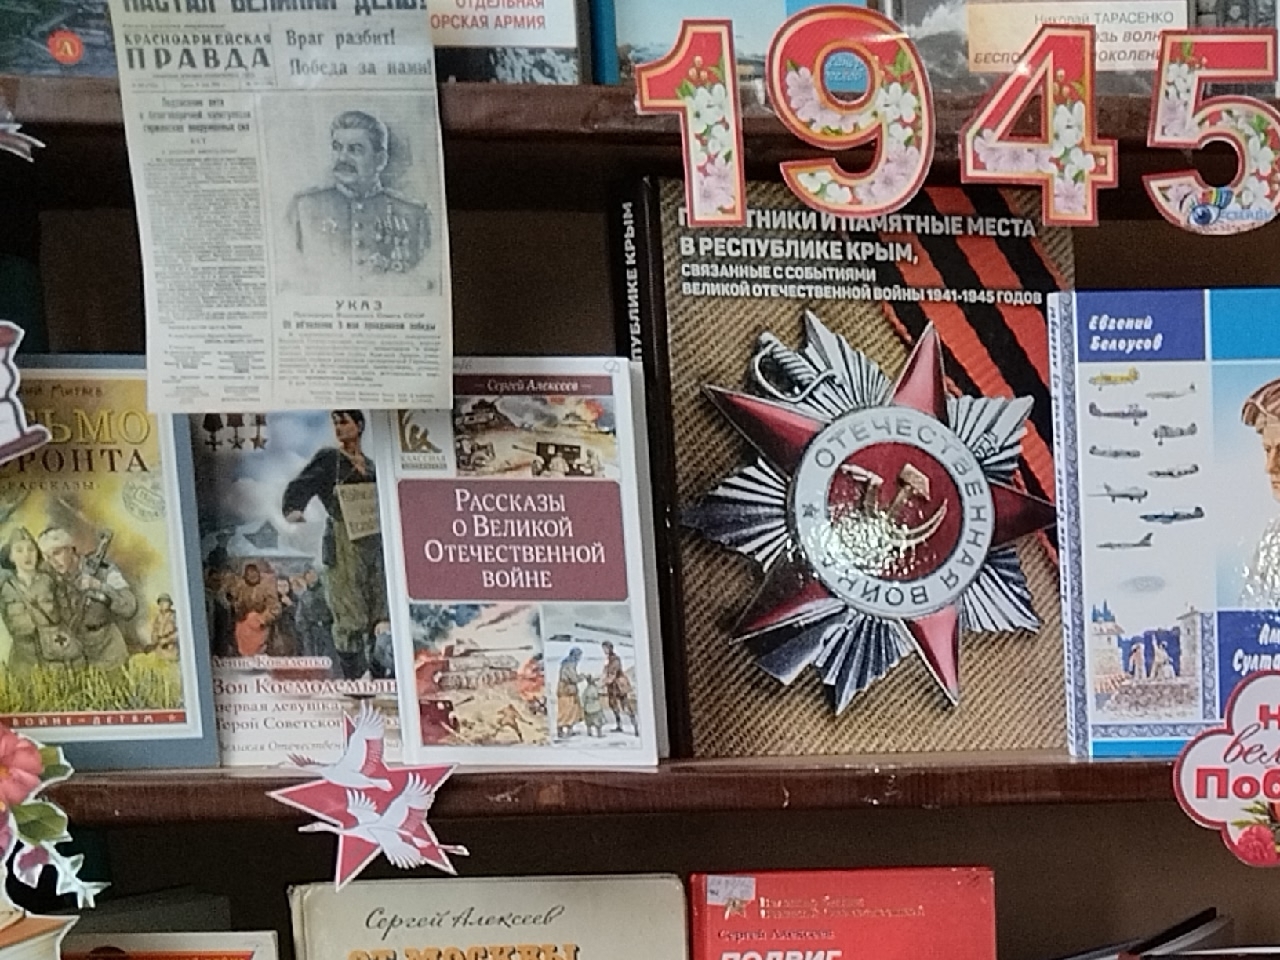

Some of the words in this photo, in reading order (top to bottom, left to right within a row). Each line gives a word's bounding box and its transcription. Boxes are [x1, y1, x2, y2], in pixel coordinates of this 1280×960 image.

[494, 16, 546, 29] АРМИЯ
[1094, 12, 1174, 24] ТАРАСЕНКО
[123, 33, 272, 46] КРАСНОАРМЕЙСКАЯ
[286, 30, 324, 49] Враг
[336, 28, 396, 49] разбит!
[126, 48, 271, 71] ПРАВДА
[290, 58, 348, 75] Победа
[358, 62, 378, 75] за
[387, 59, 432, 76] нами!
[621, 201, 637, 265] КРЫМ
[821, 212, 836, 232] И
[844, 213, 962, 235] ПАМЯТНЫЕ
[972, 215, 1037, 238] МЕСТА
[680, 236, 695, 256] В
[699, 237, 844, 260] РЕСПУБЛИКЕ
[845, 240, 919, 265] КРЫМ,
[681, 263, 772, 280] СВЯЗАННЫЕ
[773, 266, 785, 280] С
[785, 266, 876, 283] СОБЫТИЯМИ
[682, 281, 751, 299] ВЕЛИКОЙ
[752, 282, 872, 302] ОТЕЧЕСТВЕННОЙ
[873, 284, 926, 303] ВОЙНЫ
[926, 289, 995, 304] 1941-1945
[996, 290, 1043, 307] ГОДОВ
[335, 300, 383, 311] УКАЗ
[1088, 313, 1154, 331] Евгений
[1088, 333, 1164, 354] Белоусов
[526, 379, 579, 392] Алексеев
[27, 408, 151, 445] ЬМО
[0, 448, 150, 473] РОНТА
[814, 415, 990, 588] ОТЕЧЕСТВЕННАЯ
[482, 568, 552, 589] ВОЙНЕ
[213, 678, 249, 695] Зоя
[365, 907, 443, 941] Сергей
[452, 905, 565, 929] Алексеев
